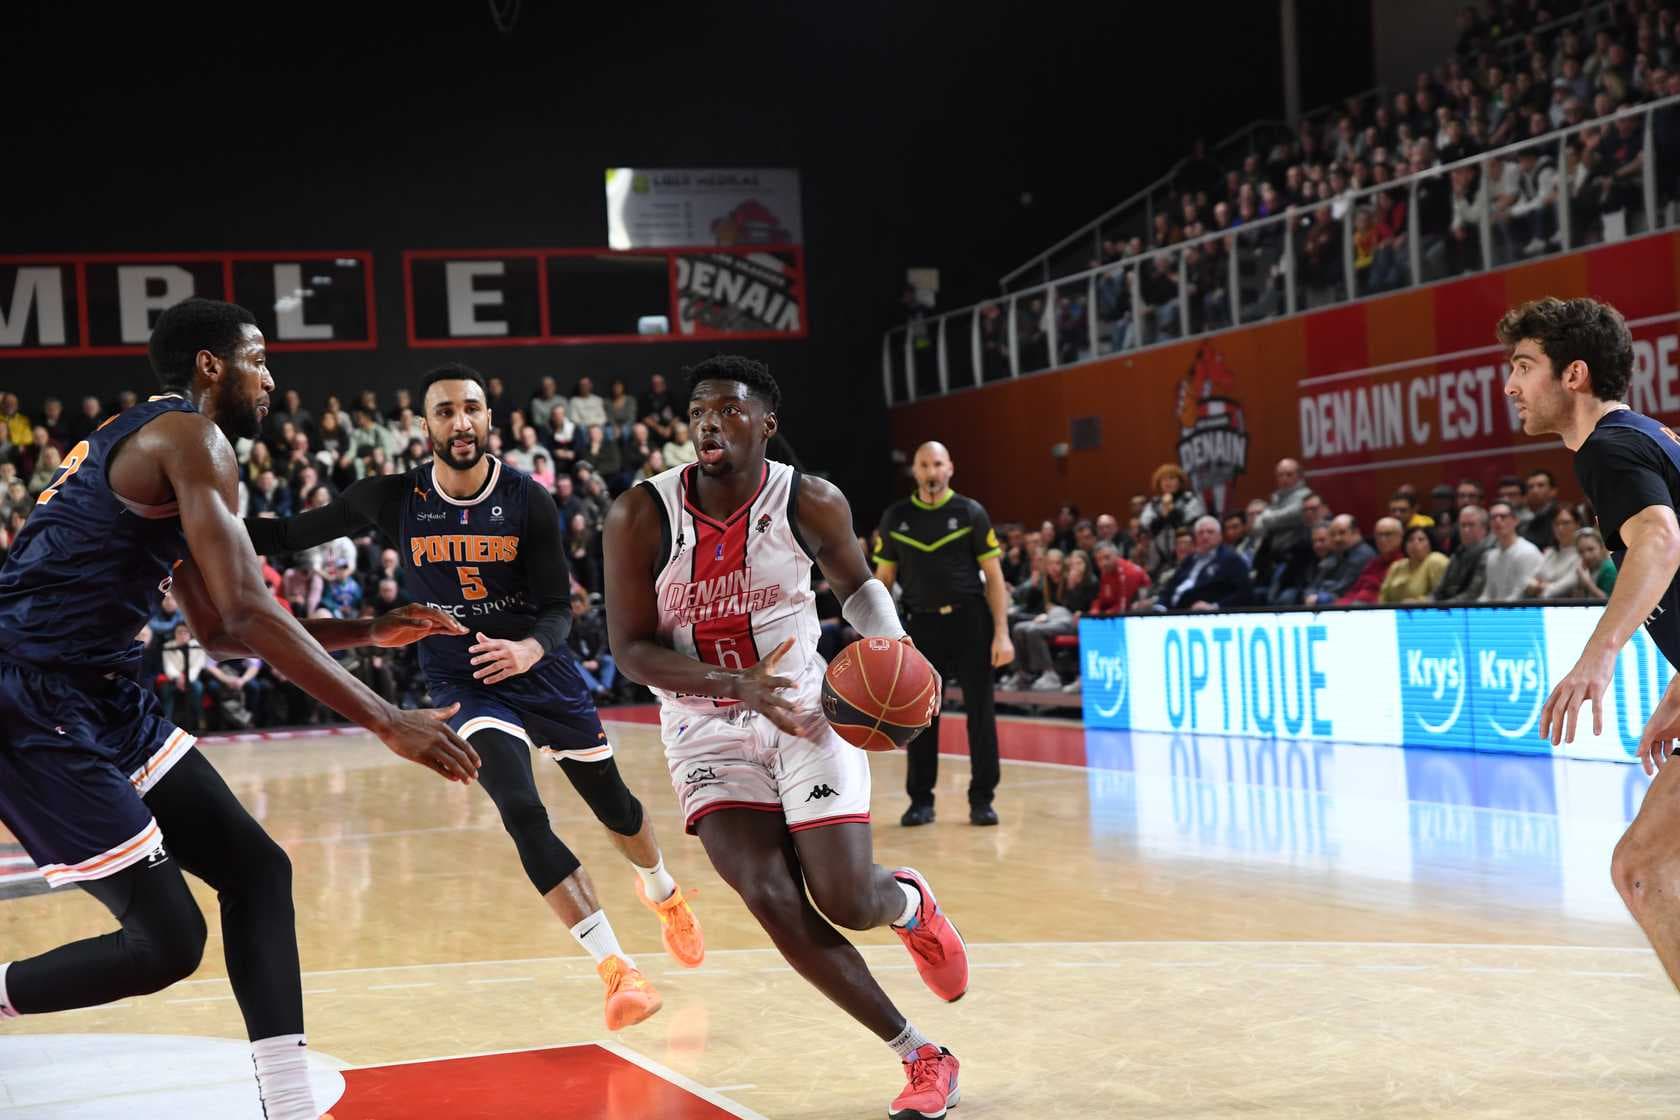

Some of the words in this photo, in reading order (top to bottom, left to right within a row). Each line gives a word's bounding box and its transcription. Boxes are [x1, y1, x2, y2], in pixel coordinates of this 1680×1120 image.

[1300, 382, 1404, 458] DENAIN
[1408, 365, 1496, 444] C'EST
[1179, 430, 1247, 473] DENAIN
[410, 534, 520, 567] POITIERS
[456, 566, 488, 600] 5
[664, 566, 752, 612] DENAIN
[673, 583, 780, 628] VOLTAIRE
[1086, 649, 1124, 692] Krys
[1164, 625, 1334, 740] OPTIQUE
[1406, 648, 1460, 701] Krys
[1478, 648, 1538, 704] Krys
